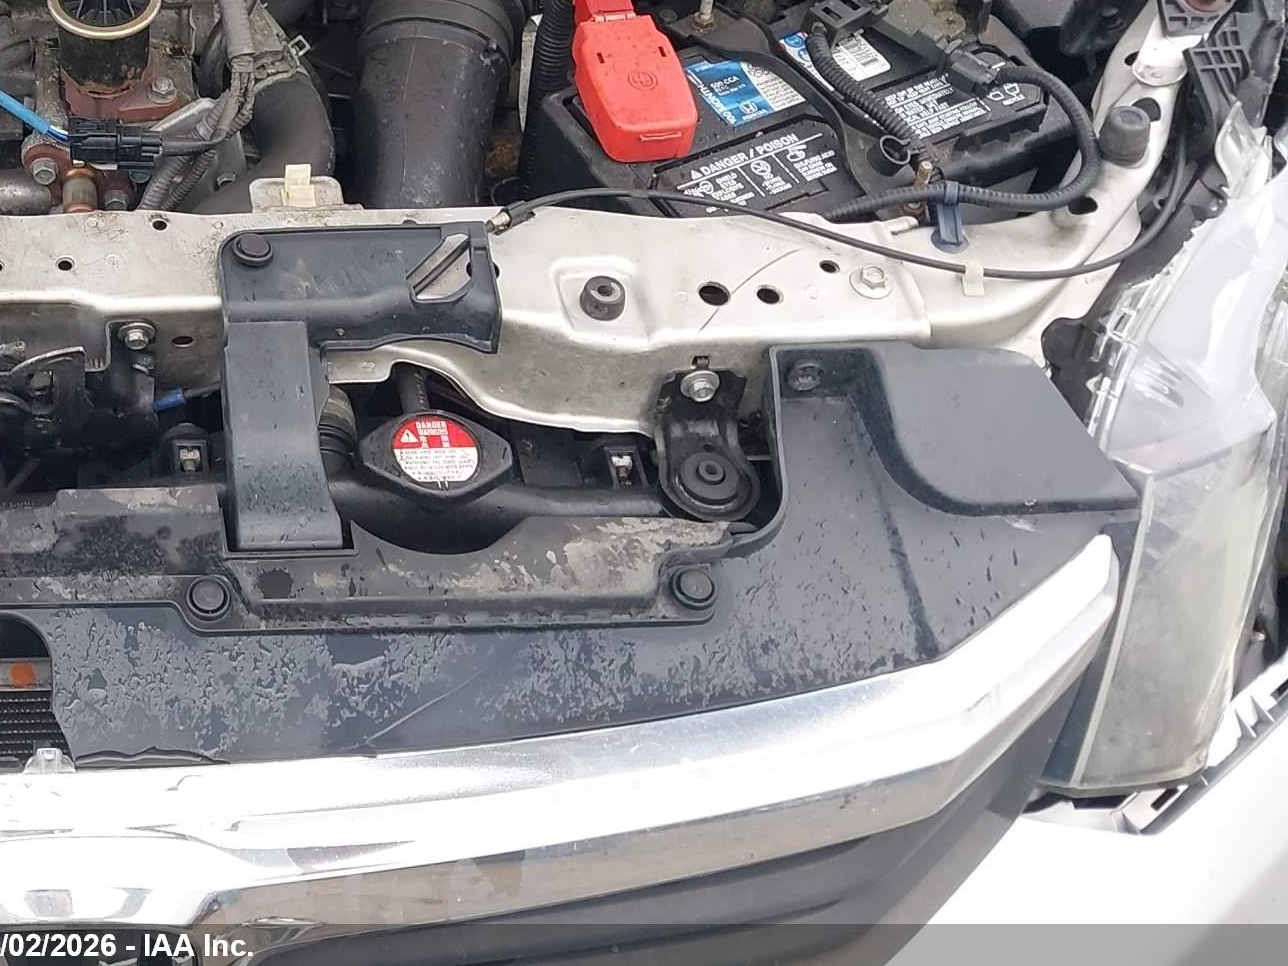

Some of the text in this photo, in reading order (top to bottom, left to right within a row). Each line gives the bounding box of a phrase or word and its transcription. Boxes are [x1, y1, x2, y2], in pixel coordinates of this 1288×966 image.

[700, 132, 799, 176] DANGER / POISON
[415, 421, 447, 429] DANGER
